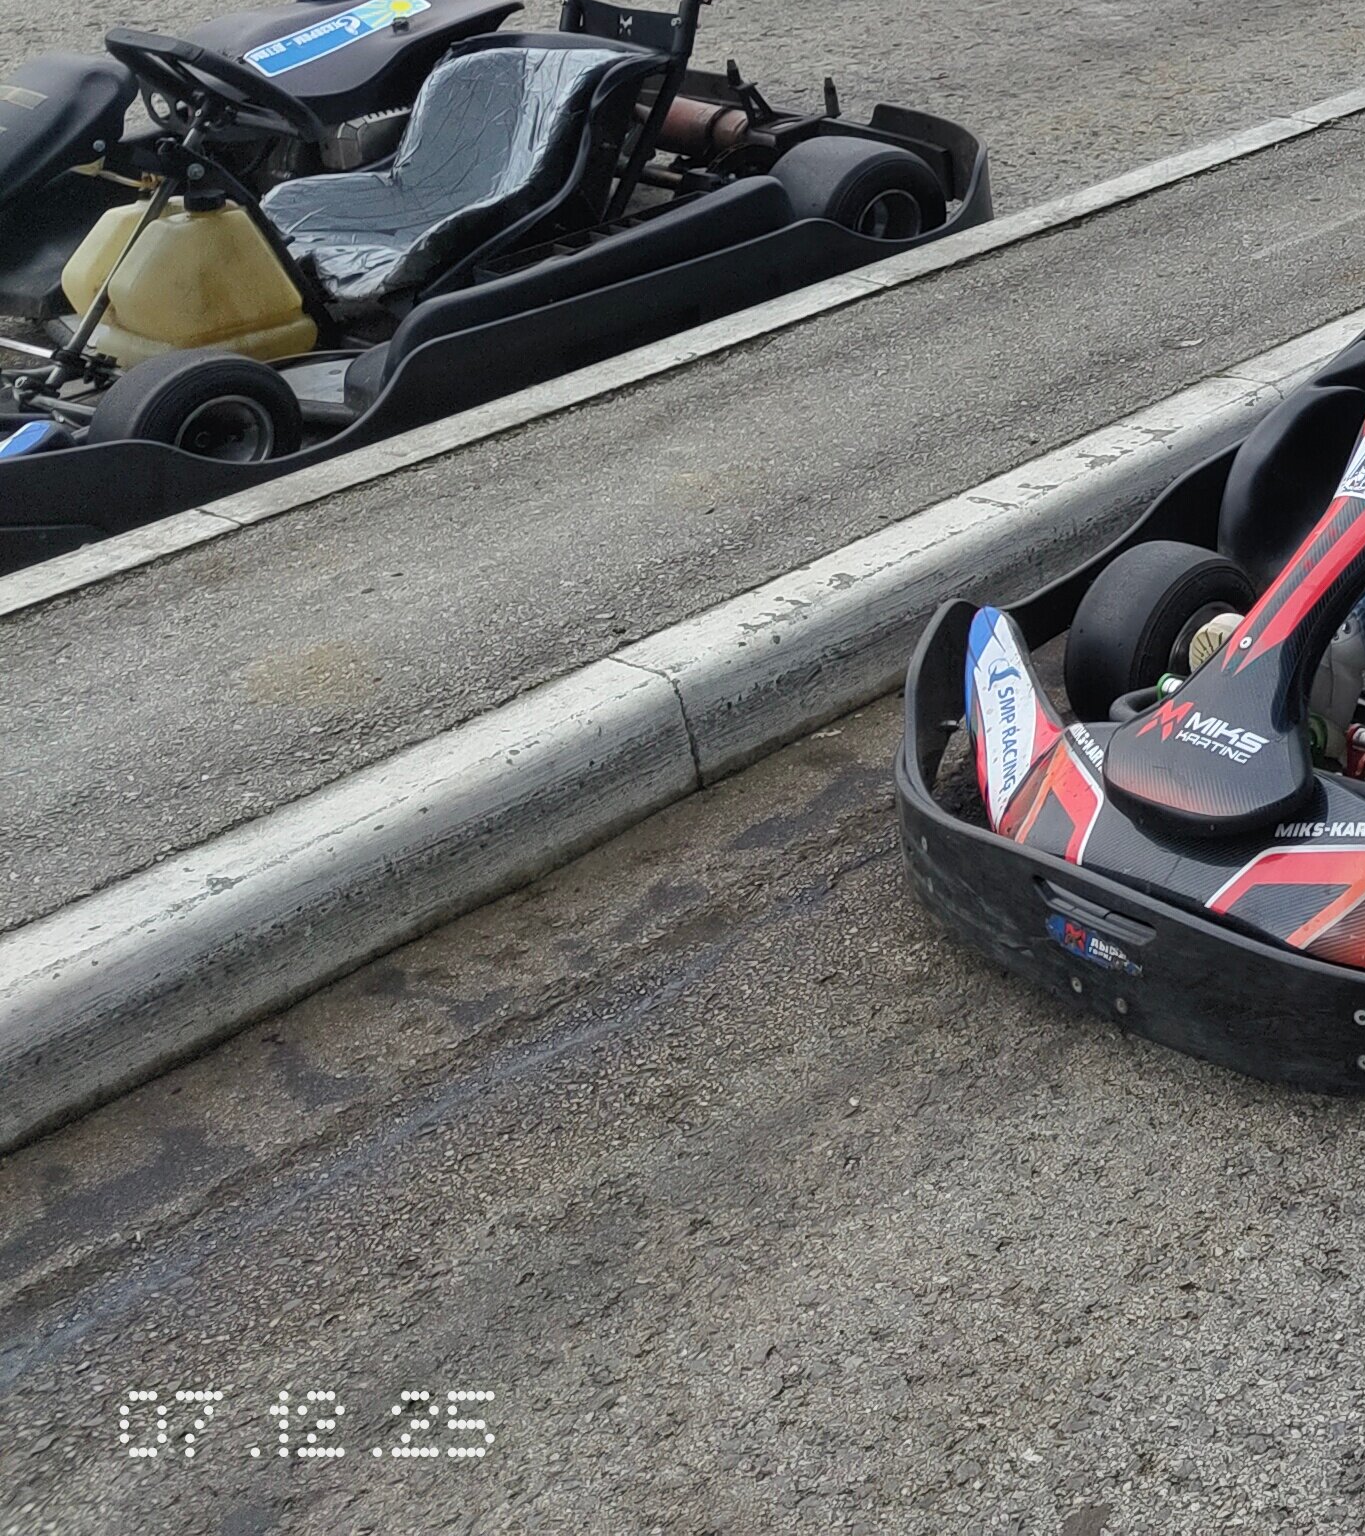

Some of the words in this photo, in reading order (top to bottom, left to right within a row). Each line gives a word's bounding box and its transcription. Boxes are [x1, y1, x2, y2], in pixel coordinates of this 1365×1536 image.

[997, 686, 1016, 726] SMP
[1174, 729, 1252, 765] KARTING
[1184, 711, 1270, 754] MIKS
[1001, 725, 1019, 795] RACING
